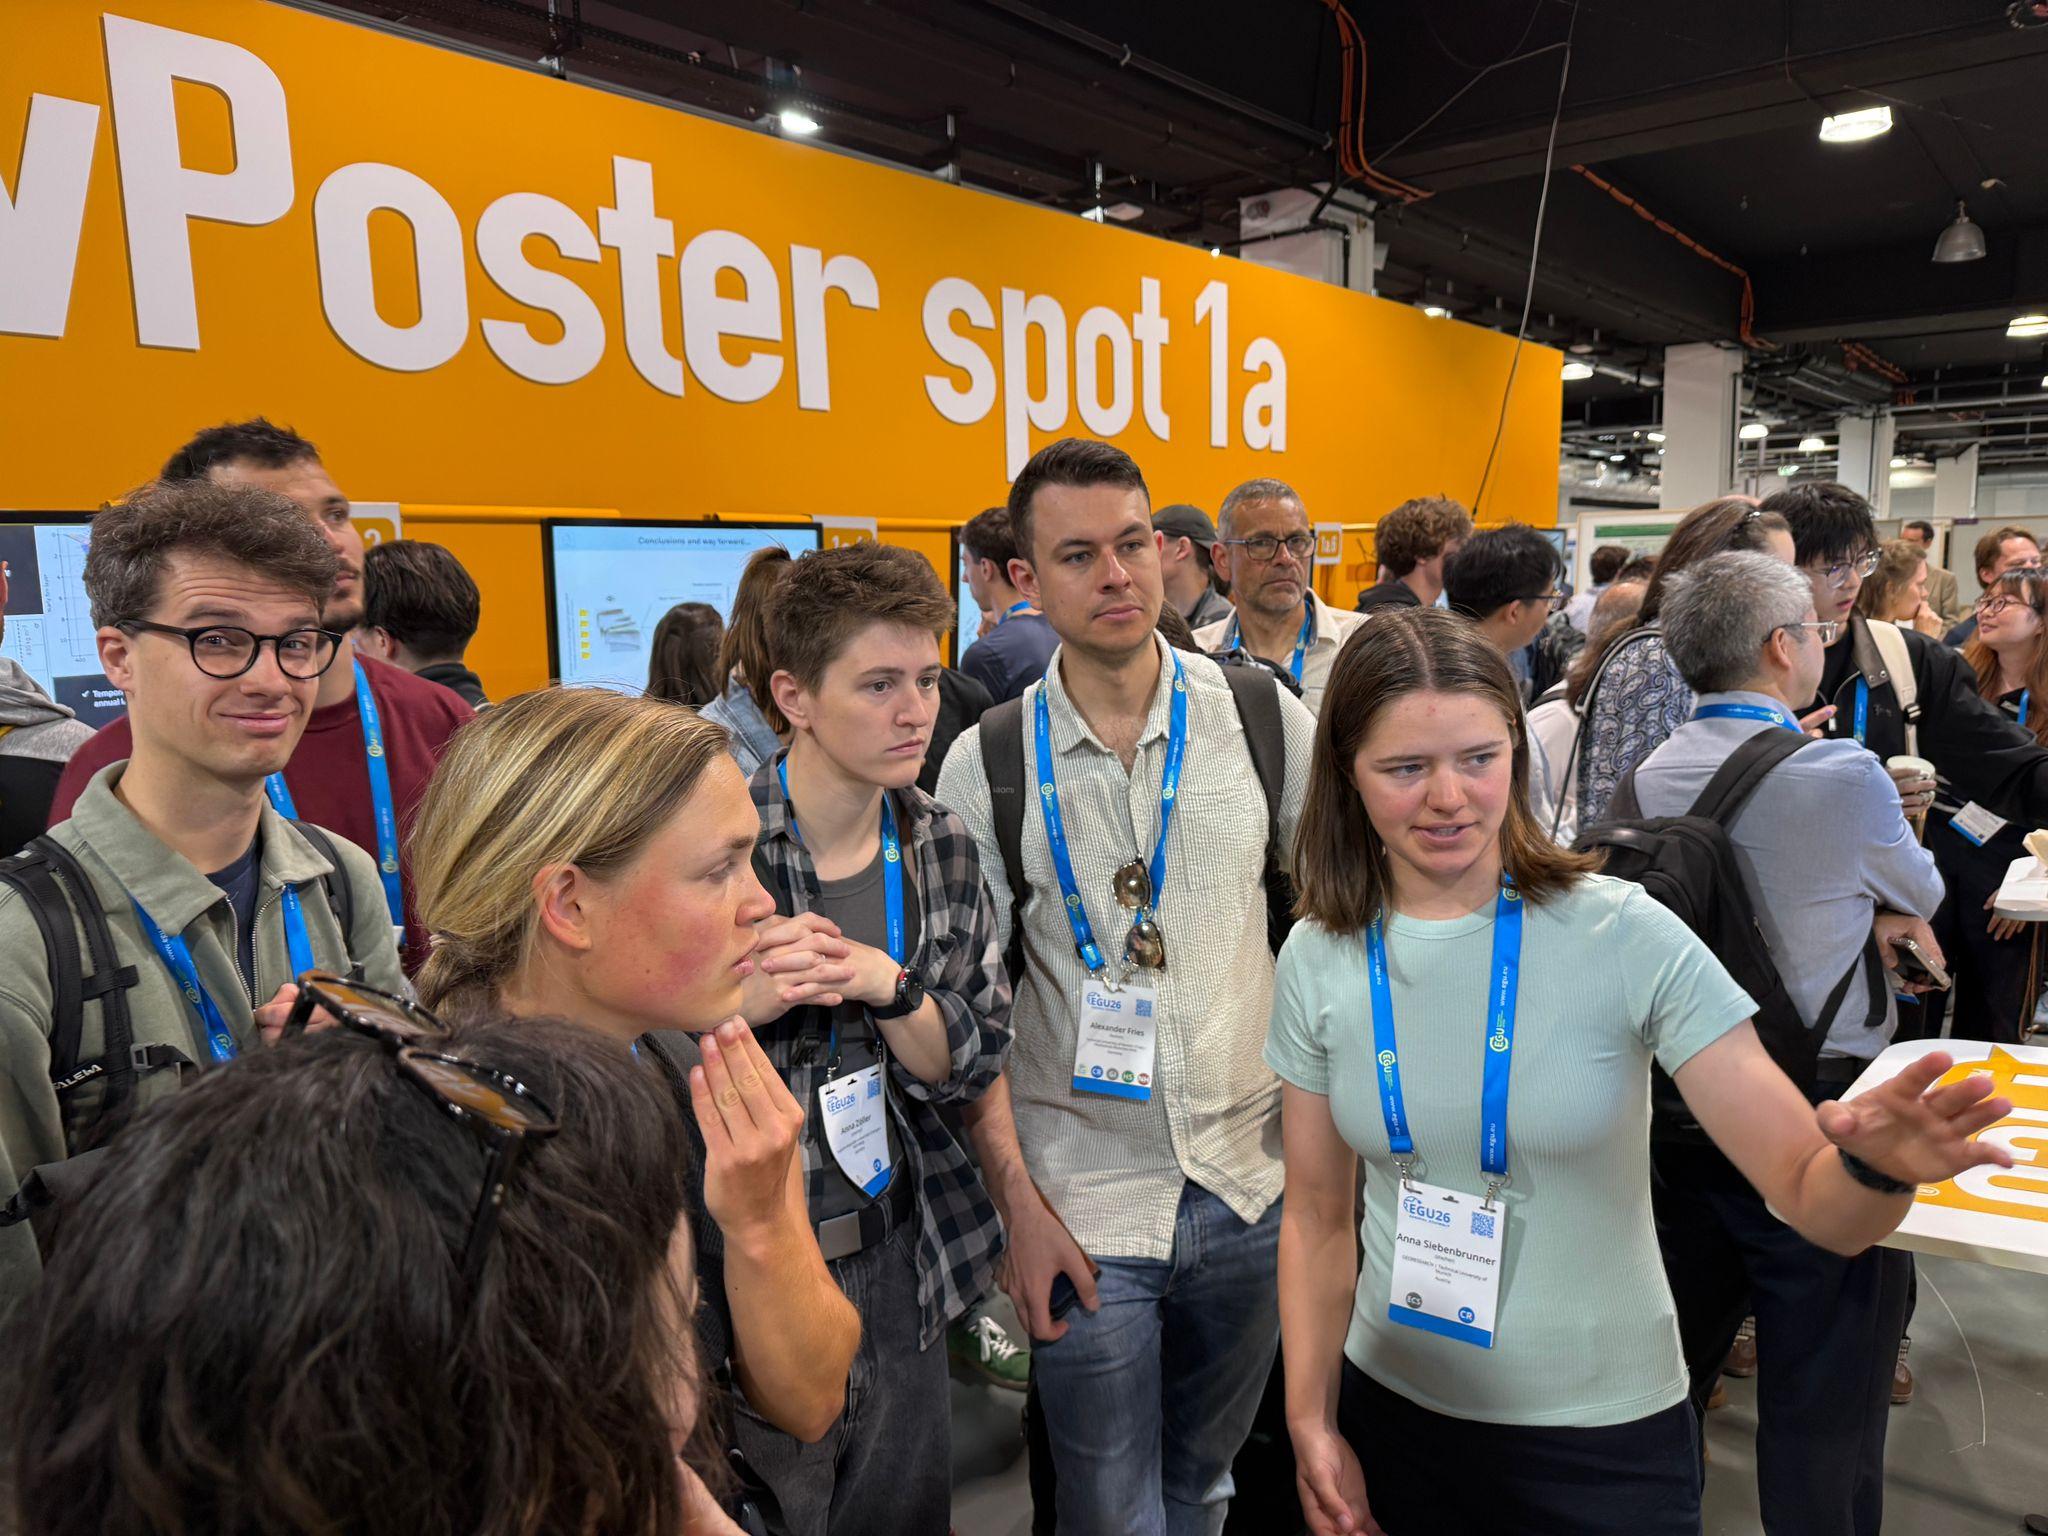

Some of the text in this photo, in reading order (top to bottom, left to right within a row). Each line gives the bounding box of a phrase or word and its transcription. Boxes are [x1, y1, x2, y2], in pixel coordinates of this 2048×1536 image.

[922, 276, 1170, 483] spot
[1193, 280, 1288, 452] 1a
[1091, 997, 1121, 1009] EGU26
[1090, 1022, 1126, 1034] Alexander
[1127, 1027, 1145, 1037] Fries
[1492, 1027, 1507, 1050] EGU
[1380, 1051, 1394, 1074] EGU
[1409, 1204, 1451, 1223] EGU26
[1397, 1233, 1496, 1265] Anna Siebenbrunner
[1460, 1310, 1473, 1320] CR
